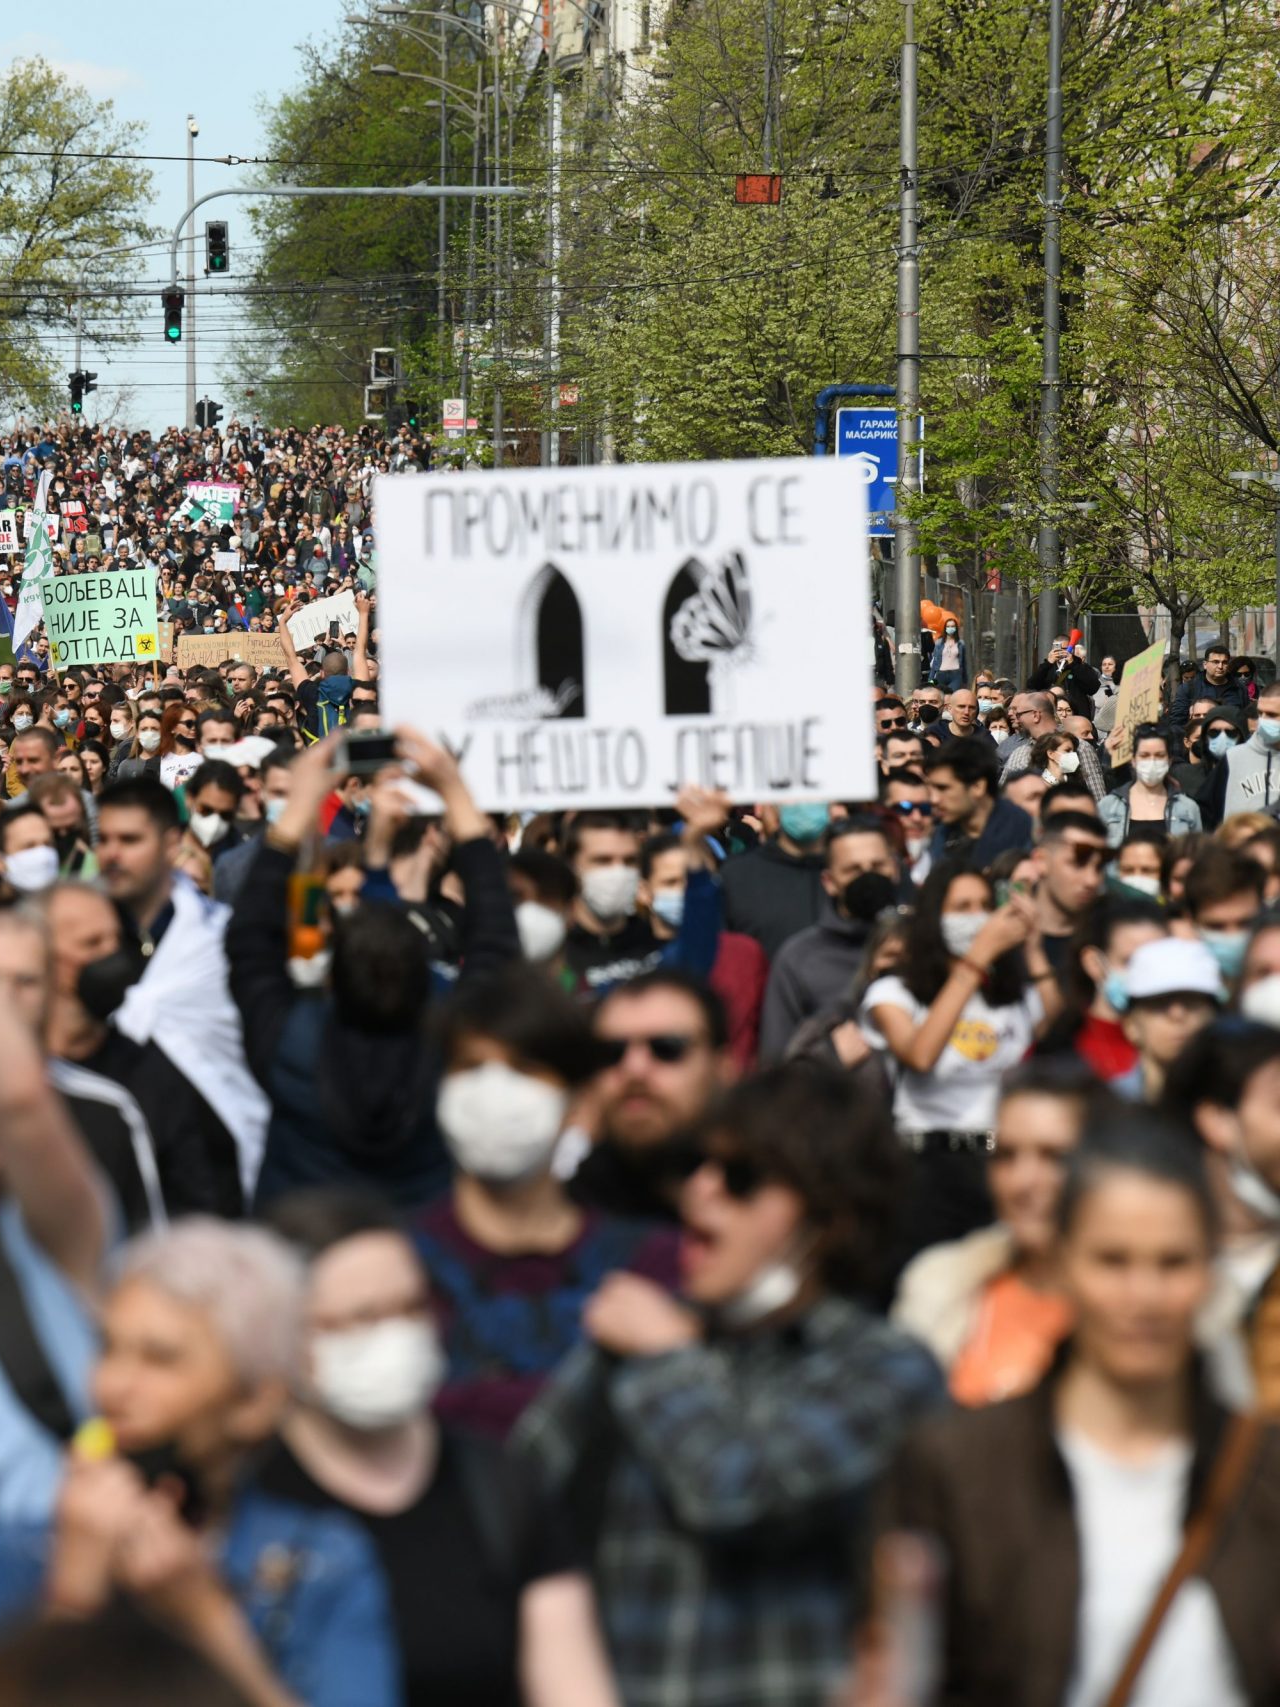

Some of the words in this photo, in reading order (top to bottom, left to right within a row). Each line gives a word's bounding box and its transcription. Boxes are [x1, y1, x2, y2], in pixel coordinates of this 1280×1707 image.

[188, 485, 241, 504] WATER
[425, 477, 718, 558] ПРОМЕНИМО
[747, 474, 807, 547] СЕ
[43, 577, 148, 606] БОЉЕВАЦ
[50, 610, 100, 636] НИЈЕ
[113, 607, 143, 629] ЗА
[58, 635, 136, 662] ОТПАД
[494, 728, 648, 794] НЕШТО
[665, 717, 823, 793] ЛЕПШЕ
[1240, 771, 1280, 799] NIK
